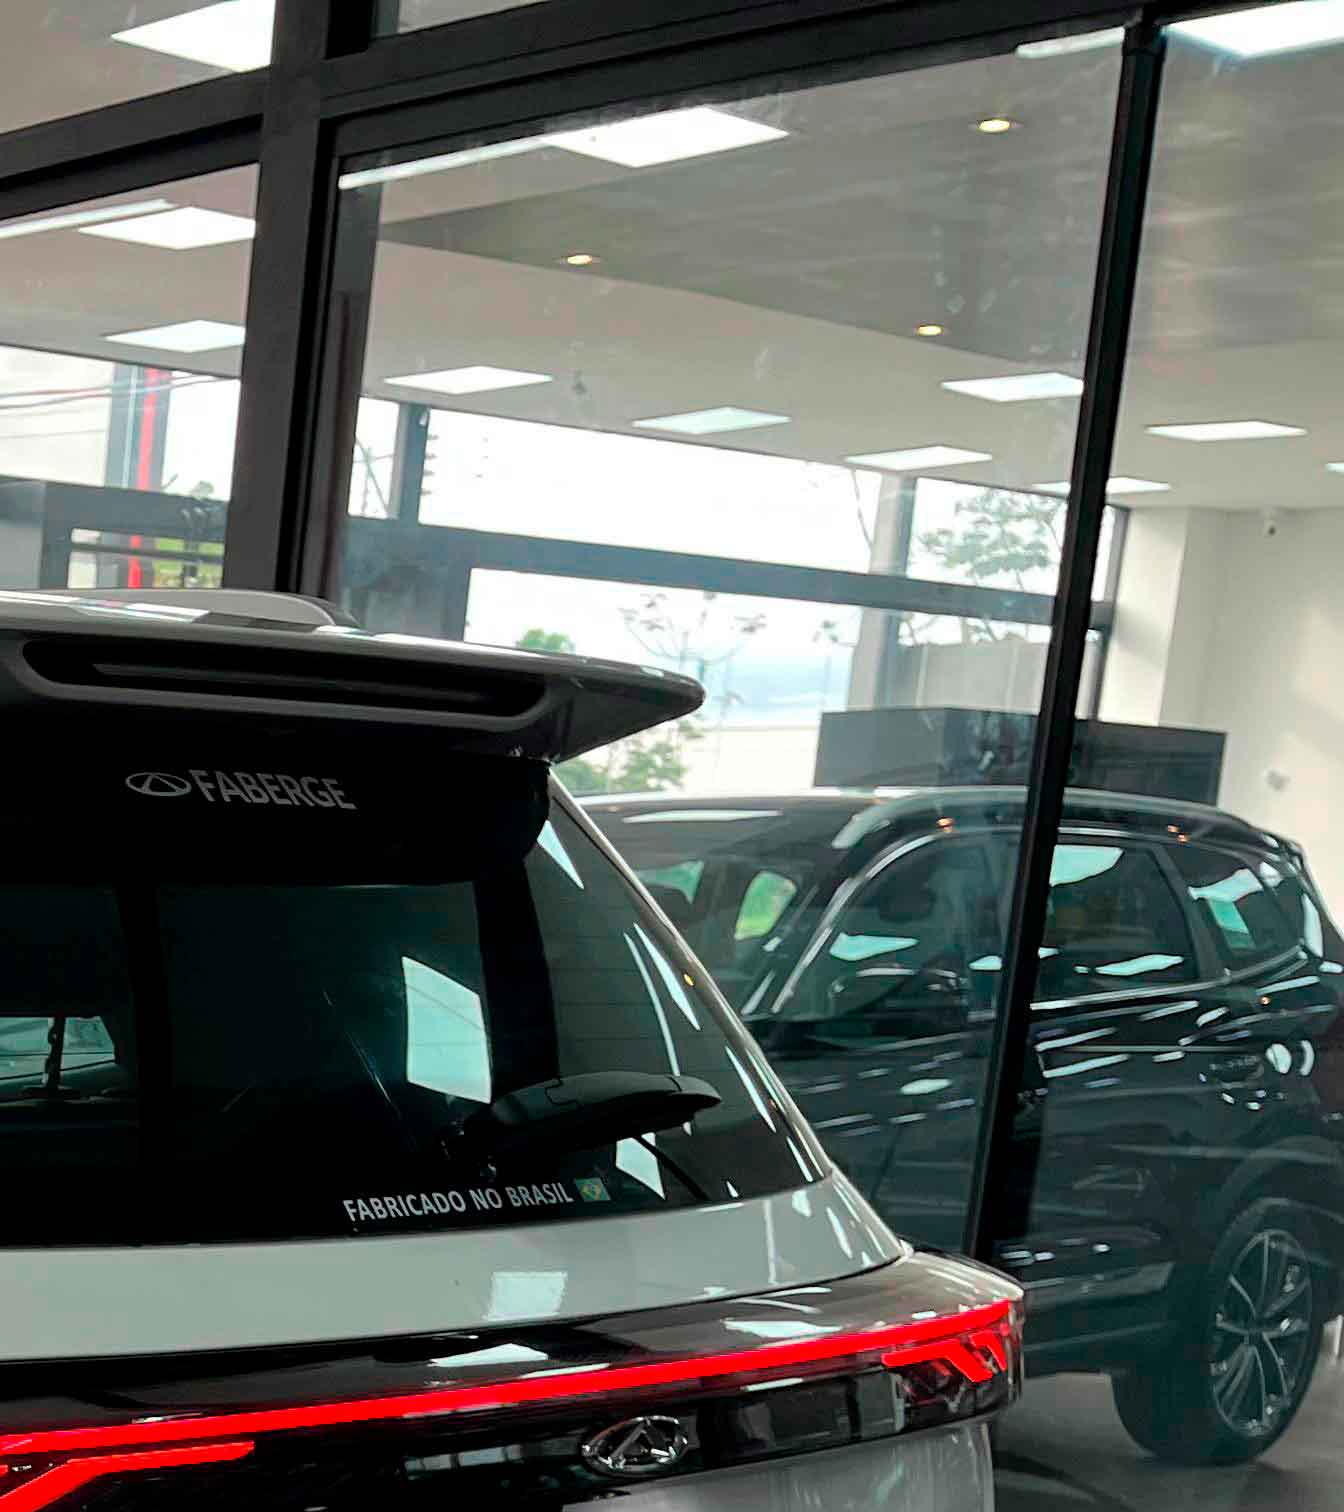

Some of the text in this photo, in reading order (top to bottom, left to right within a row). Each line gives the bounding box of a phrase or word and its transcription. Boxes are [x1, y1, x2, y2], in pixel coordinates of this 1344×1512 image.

[188, 769, 358, 809] FABERGE
[343, 1182, 575, 1222] FABRICADO NO BRASIL
